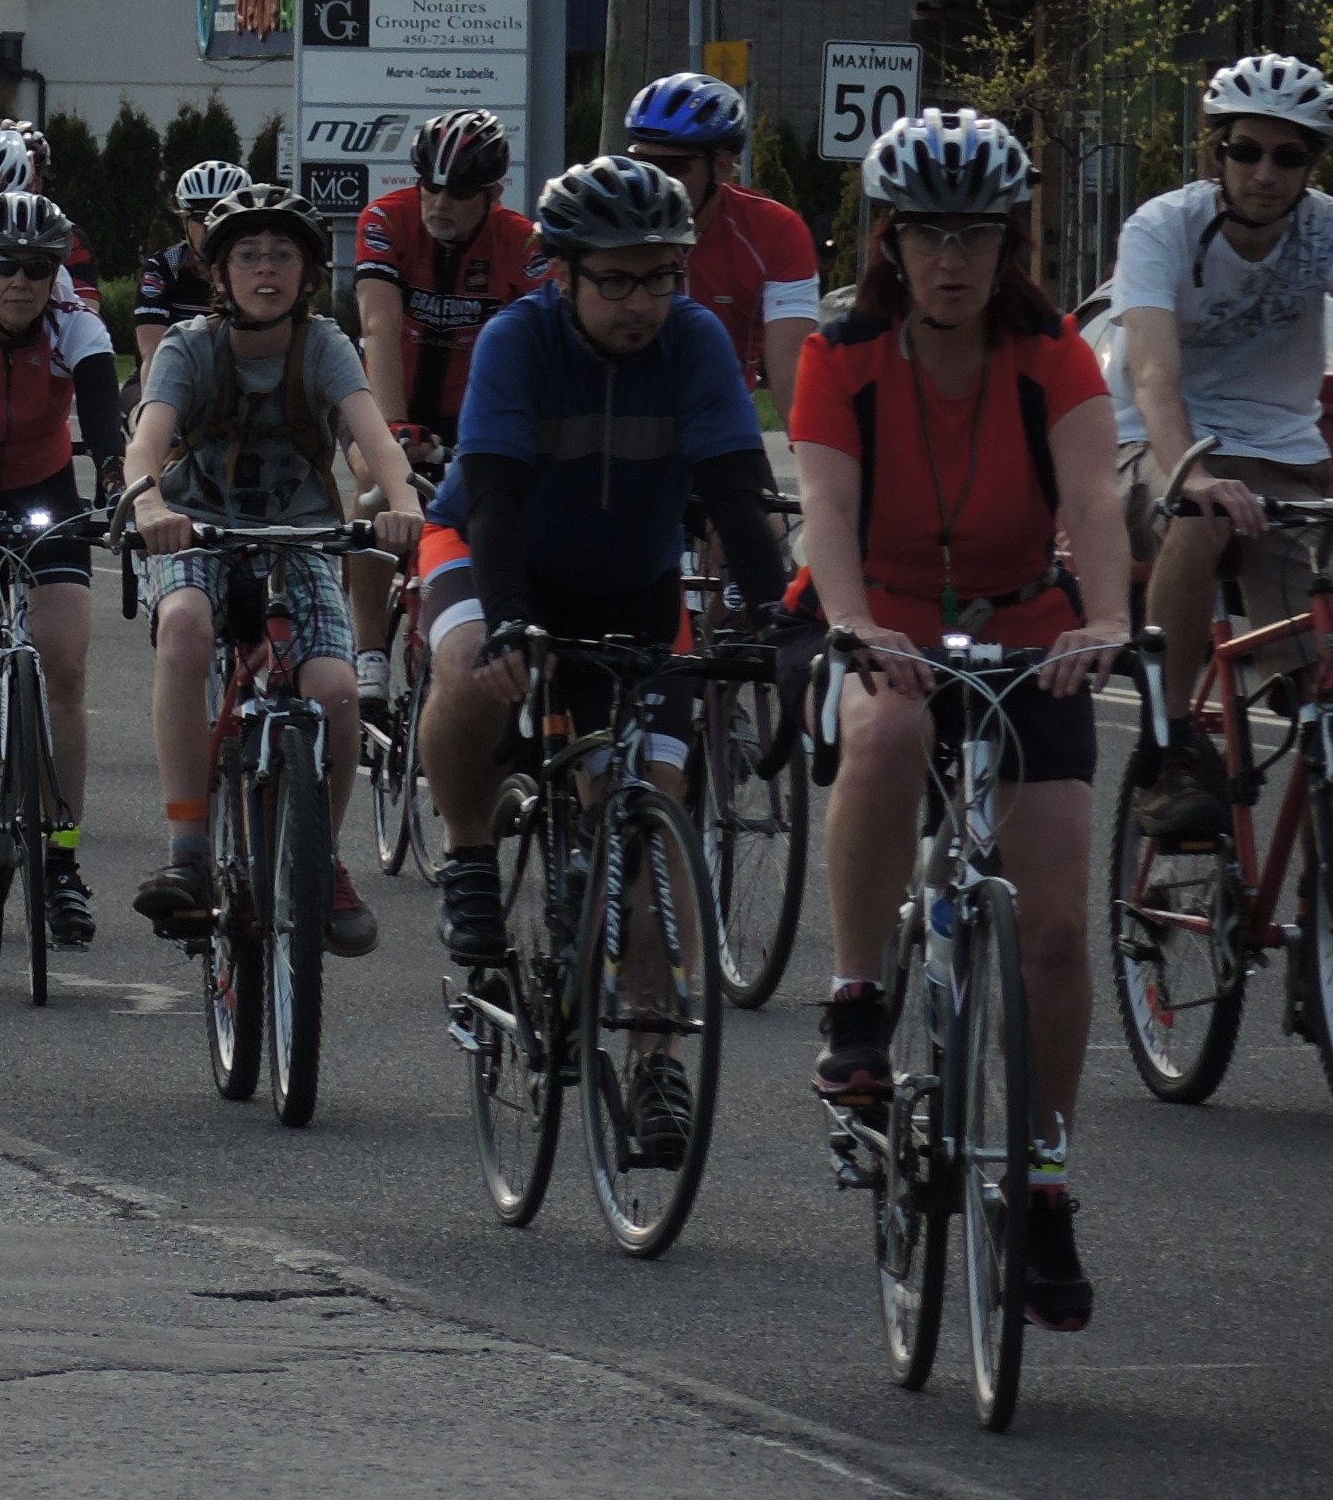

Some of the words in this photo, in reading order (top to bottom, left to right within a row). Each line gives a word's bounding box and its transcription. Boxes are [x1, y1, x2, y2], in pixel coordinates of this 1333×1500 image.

[413, 0, 487, 14] Notaires
[375, 16, 441, 32] Groupe
[447, 16, 523, 30] Conseils
[402, 35, 495, 46] 450-724-8034
[832, 53, 913, 71] MAXIMUM
[386, 67, 451, 78] Marie-Claude
[834, 83, 906, 142] 50
[310, 176, 360, 200] MC
